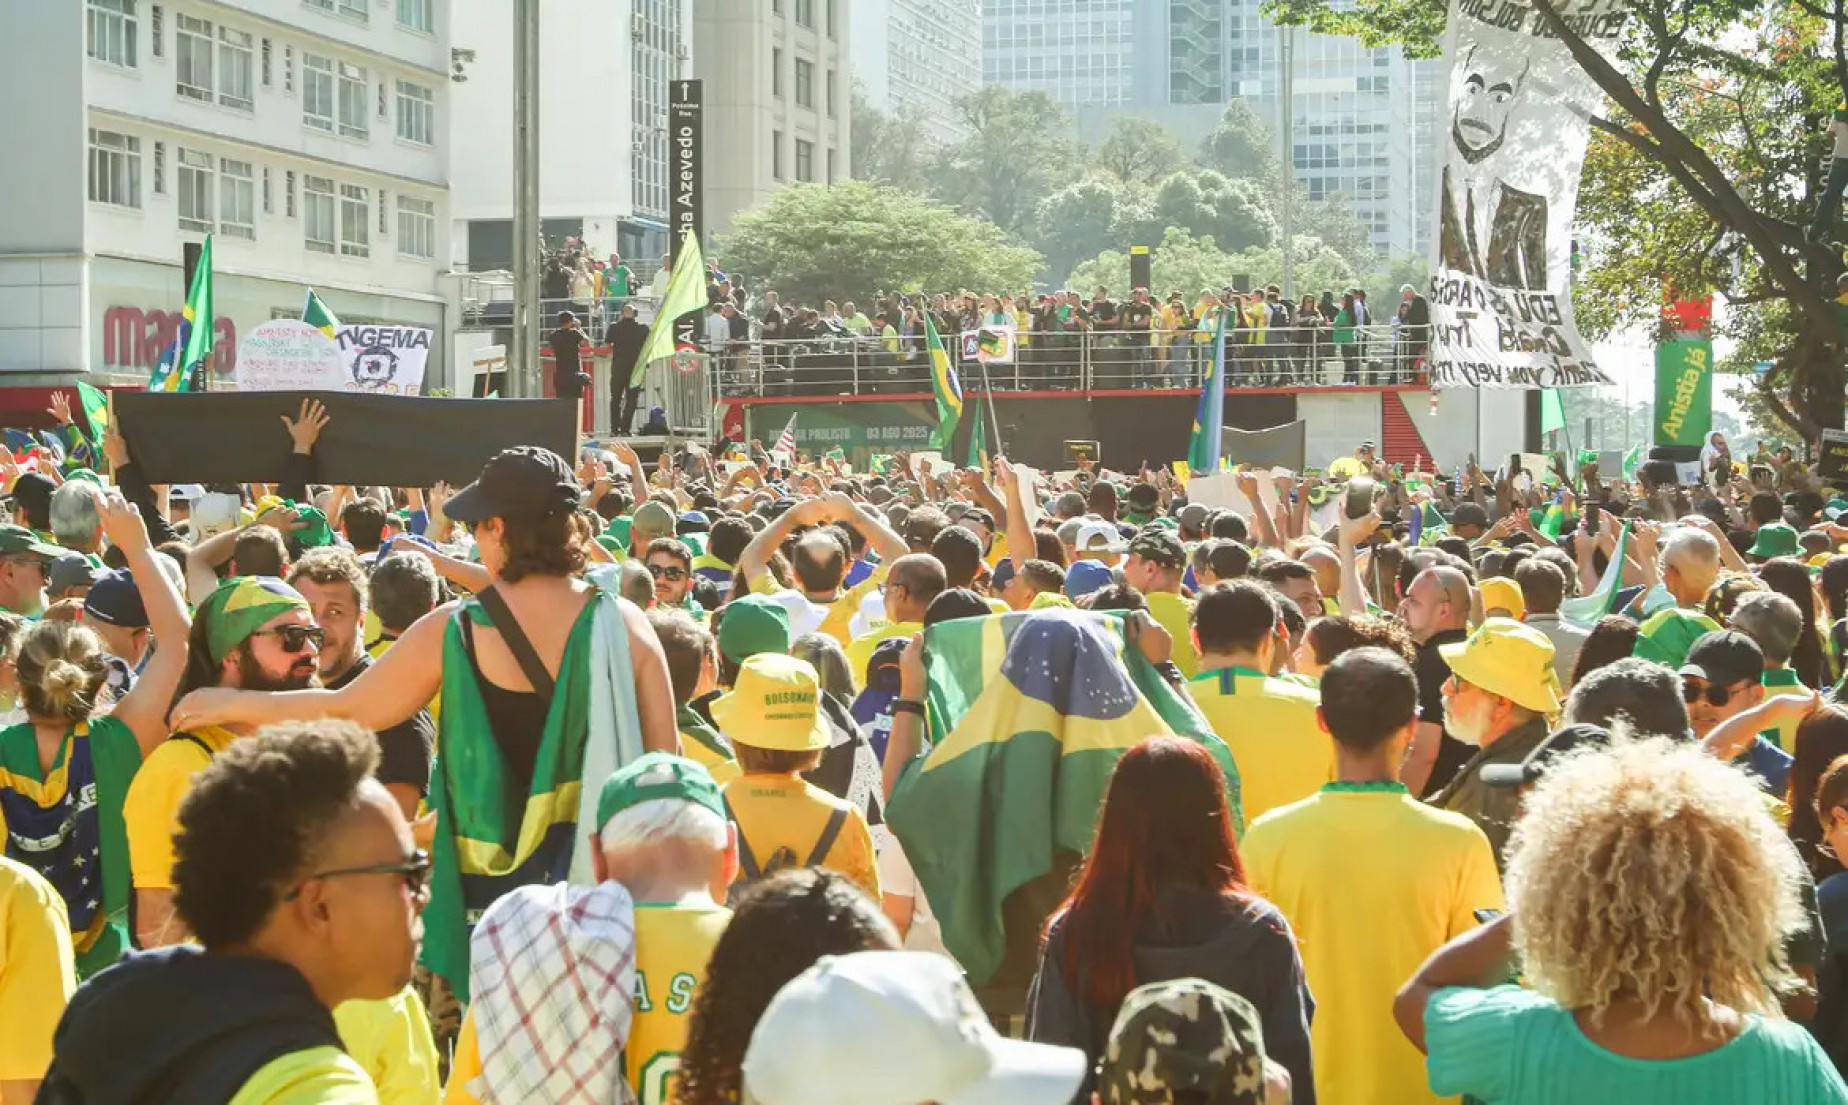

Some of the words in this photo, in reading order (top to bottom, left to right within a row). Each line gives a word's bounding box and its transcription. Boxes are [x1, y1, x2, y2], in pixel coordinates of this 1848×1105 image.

[677, 126, 694, 207] Azevedo
[103, 306, 237, 374] mara
[677, 318, 694, 345] Al.
[1662, 369, 1700, 439] Anistia
[1684, 347, 1706, 373] já
[866, 427, 879, 439] 03
[882, 426, 900, 439] AGO
[903, 425, 928, 438] 2025
